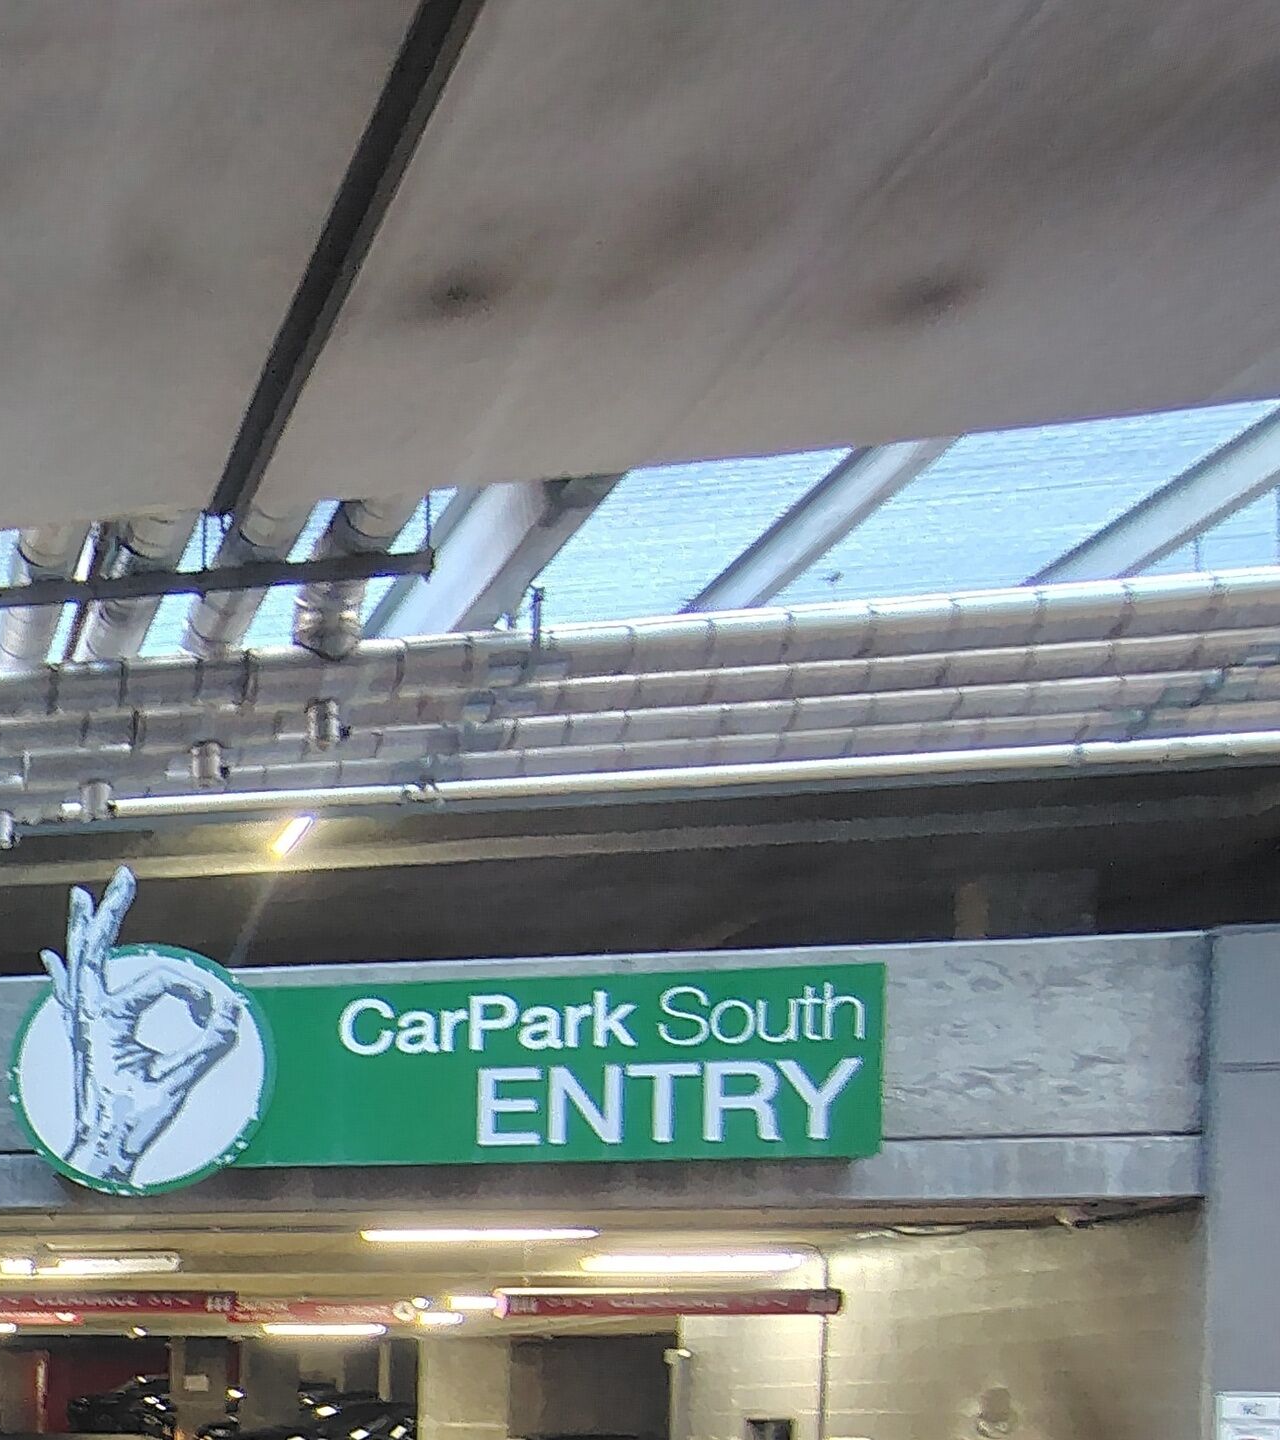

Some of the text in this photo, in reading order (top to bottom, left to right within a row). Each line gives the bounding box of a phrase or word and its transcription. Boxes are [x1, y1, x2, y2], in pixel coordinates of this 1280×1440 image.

[339, 982, 867, 1056] CarPark South
[476, 1056, 864, 1147] ENTRY
